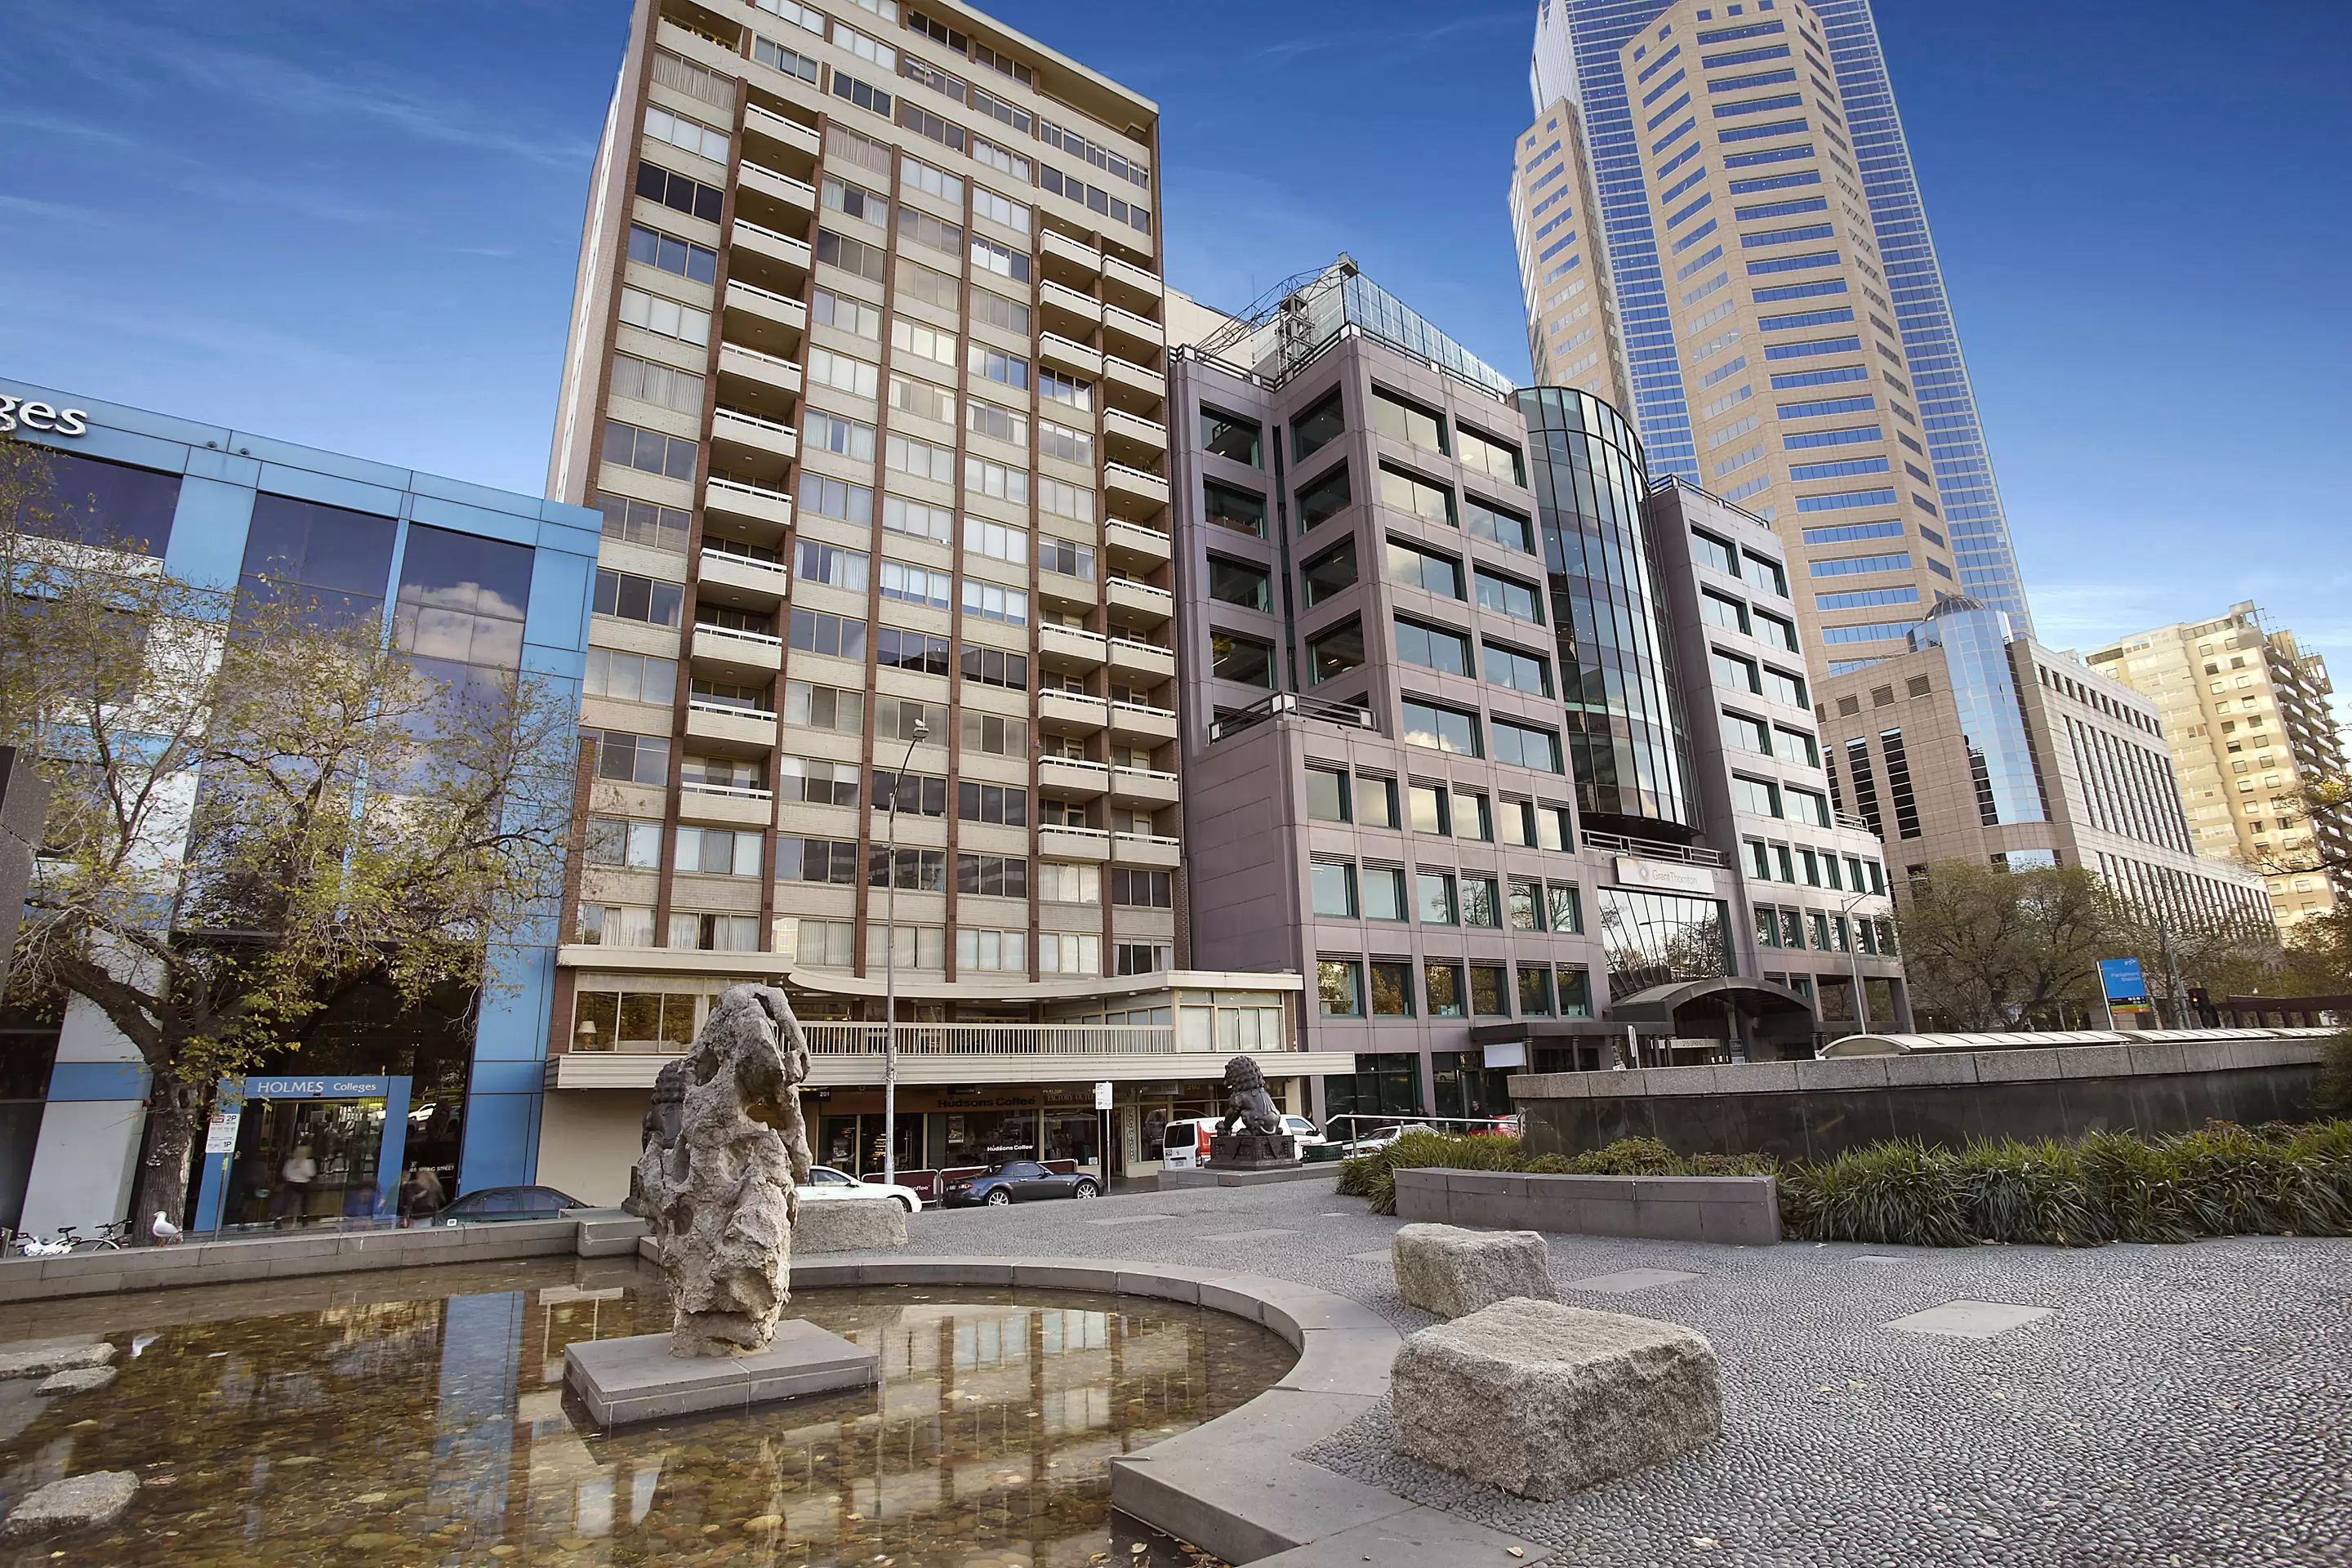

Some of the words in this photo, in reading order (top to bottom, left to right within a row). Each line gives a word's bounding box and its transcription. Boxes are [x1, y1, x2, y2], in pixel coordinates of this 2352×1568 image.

[257, 1081, 323, 1093] HOLMES
[333, 1082, 376, 1093] Colleges
[938, 1097, 994, 1108] Hudsons
[996, 1096, 1036, 1106] Coffee
[1075, 1093, 1095, 1101] OUTLE
[987, 1144, 1013, 1152] Hudsons
